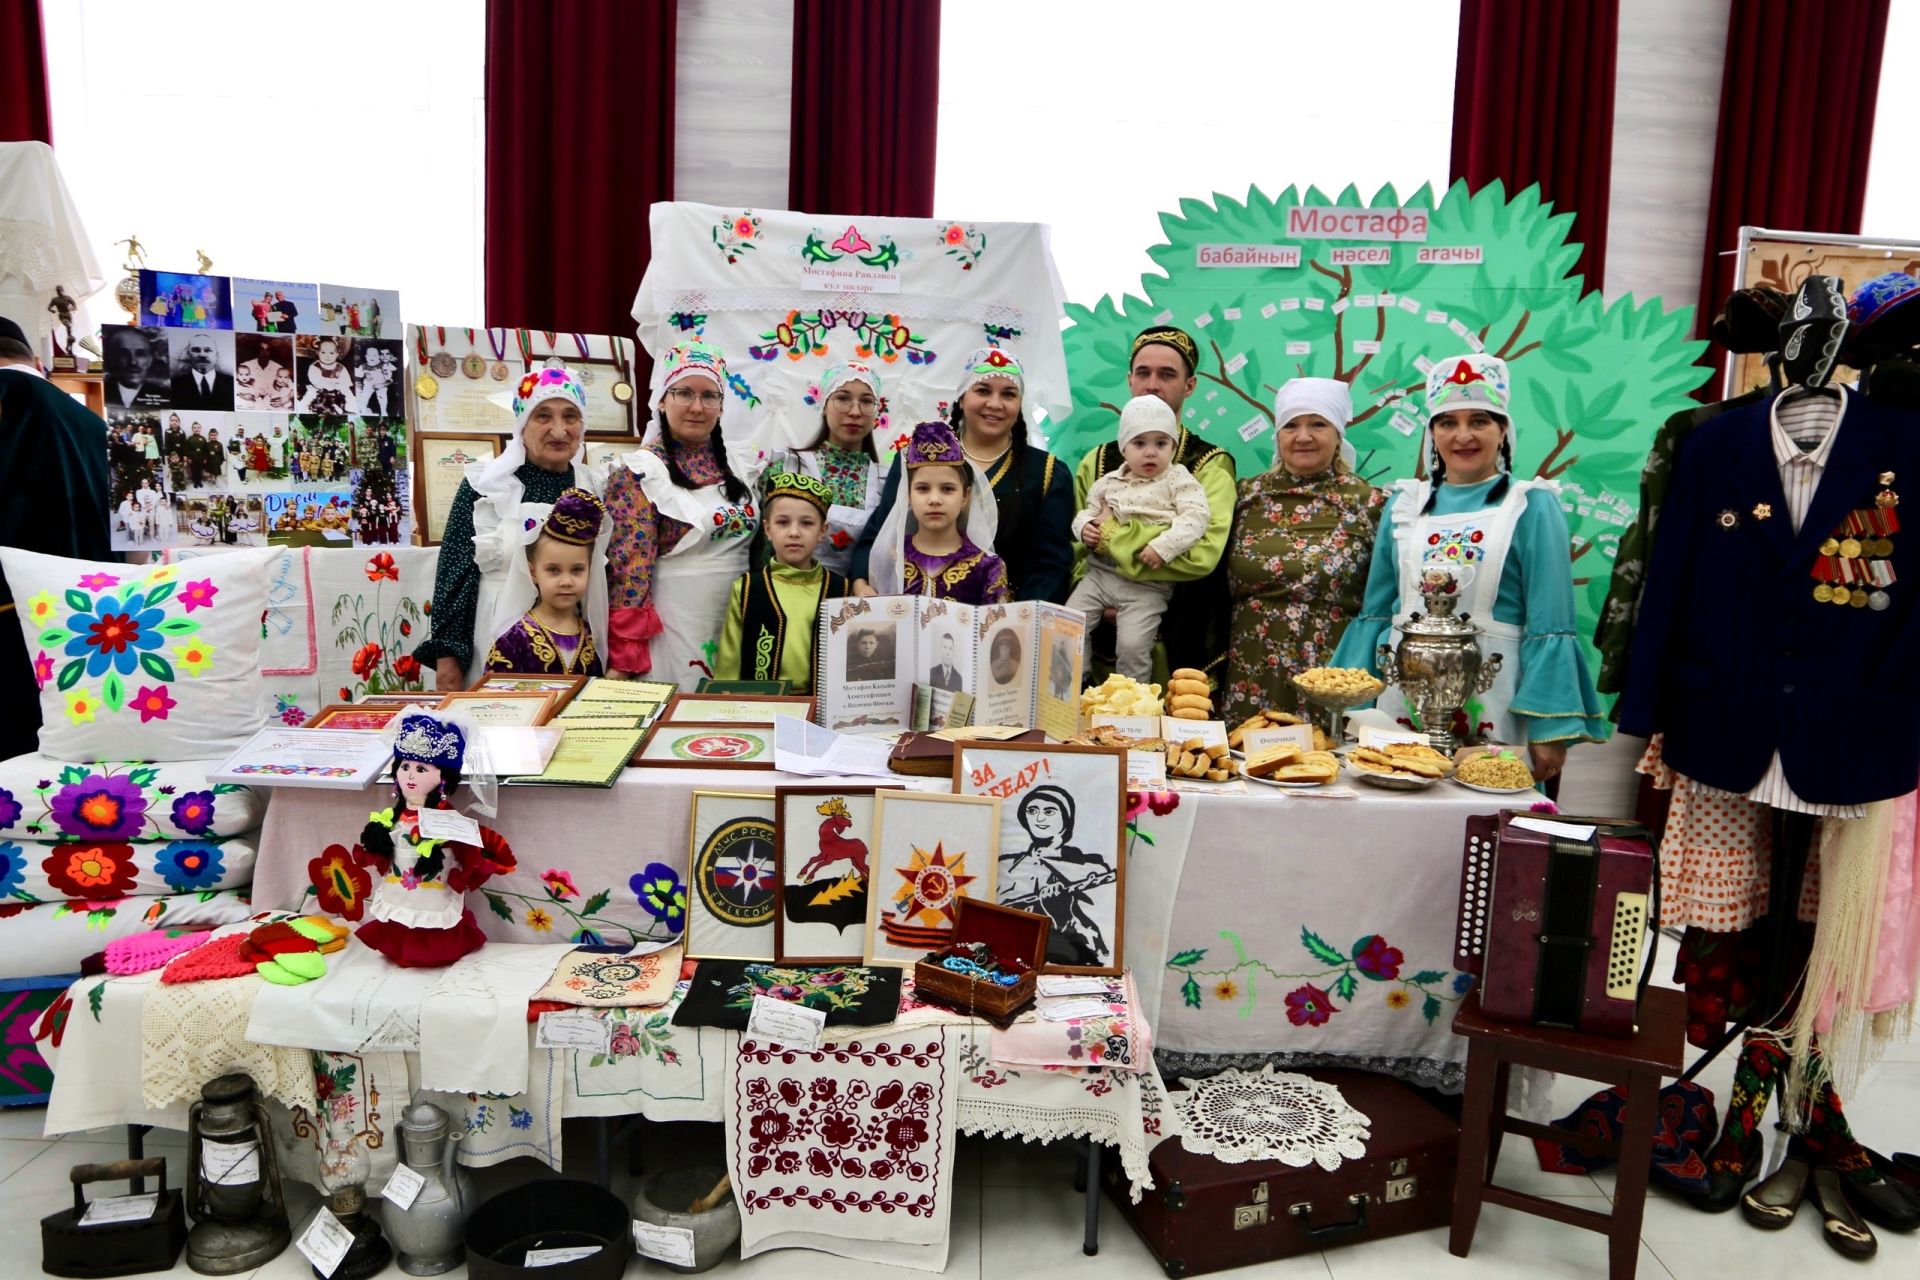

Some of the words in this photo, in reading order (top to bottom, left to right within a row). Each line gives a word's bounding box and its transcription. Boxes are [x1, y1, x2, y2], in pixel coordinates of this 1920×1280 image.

[1290, 208, 1427, 239] Мостафа
[1200, 247, 1297, 267] бабайның
[1333, 249, 1390, 262] нәсел
[1419, 248, 1480, 261] агачы
[971, 762, 996, 787] ЗА
[978, 758, 1052, 798] БЕДУ!
[714, 832, 738, 856] МЧС
[742, 828, 774, 841] РОСС
